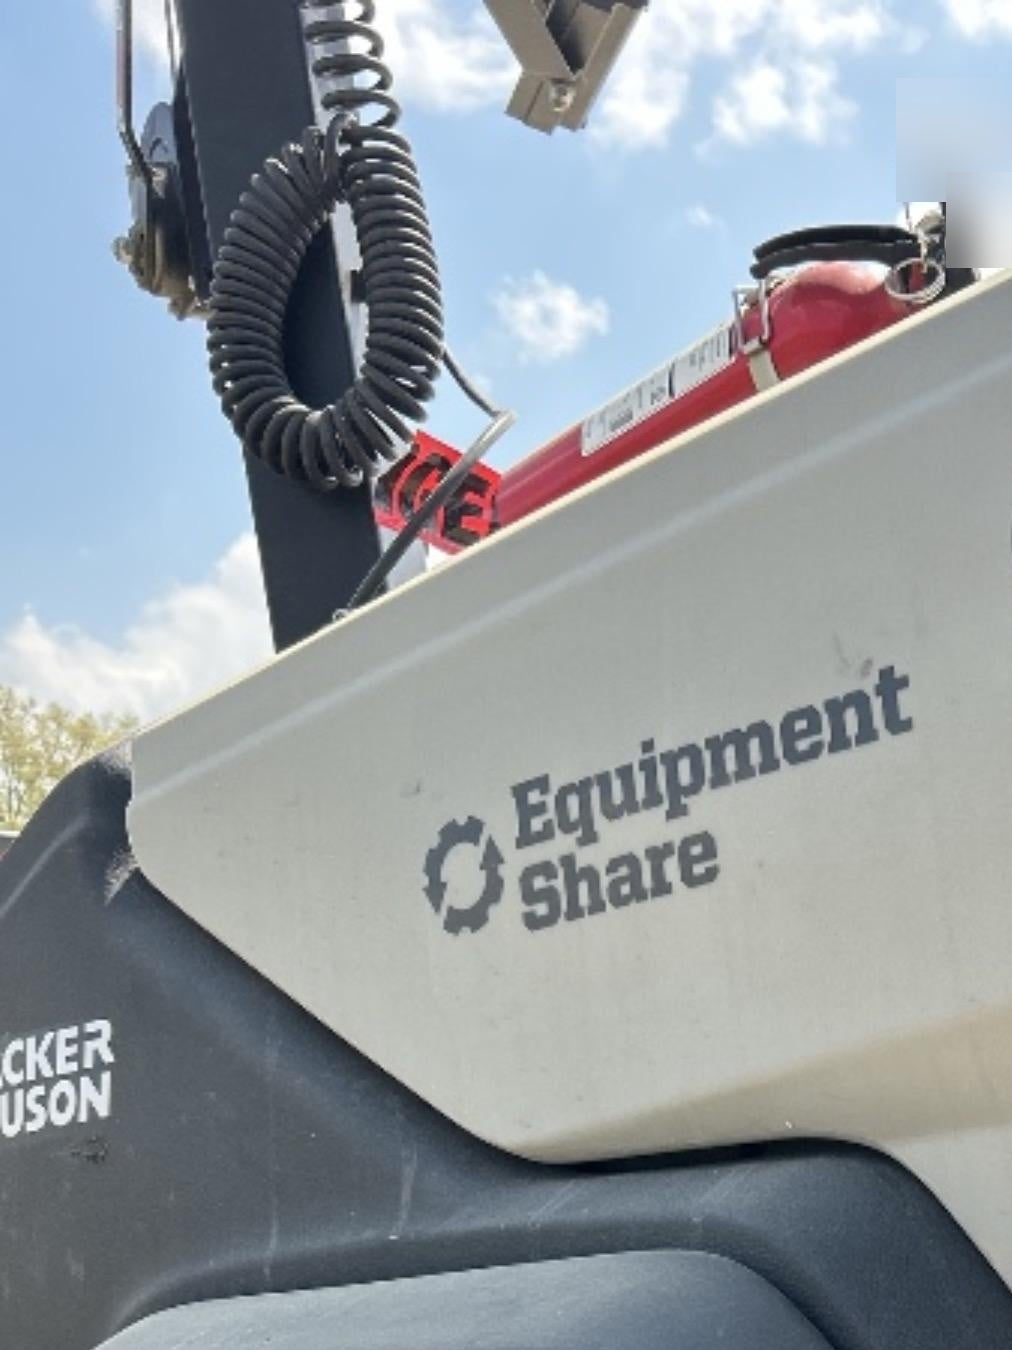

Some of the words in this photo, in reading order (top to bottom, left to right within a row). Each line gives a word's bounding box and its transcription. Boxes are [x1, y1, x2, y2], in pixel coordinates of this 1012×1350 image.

[510, 665, 914, 849] Equipment
[519, 830, 720, 932] Share
[0, 1019, 115, 1086] CKER
[0, 1070, 111, 1138] USON
